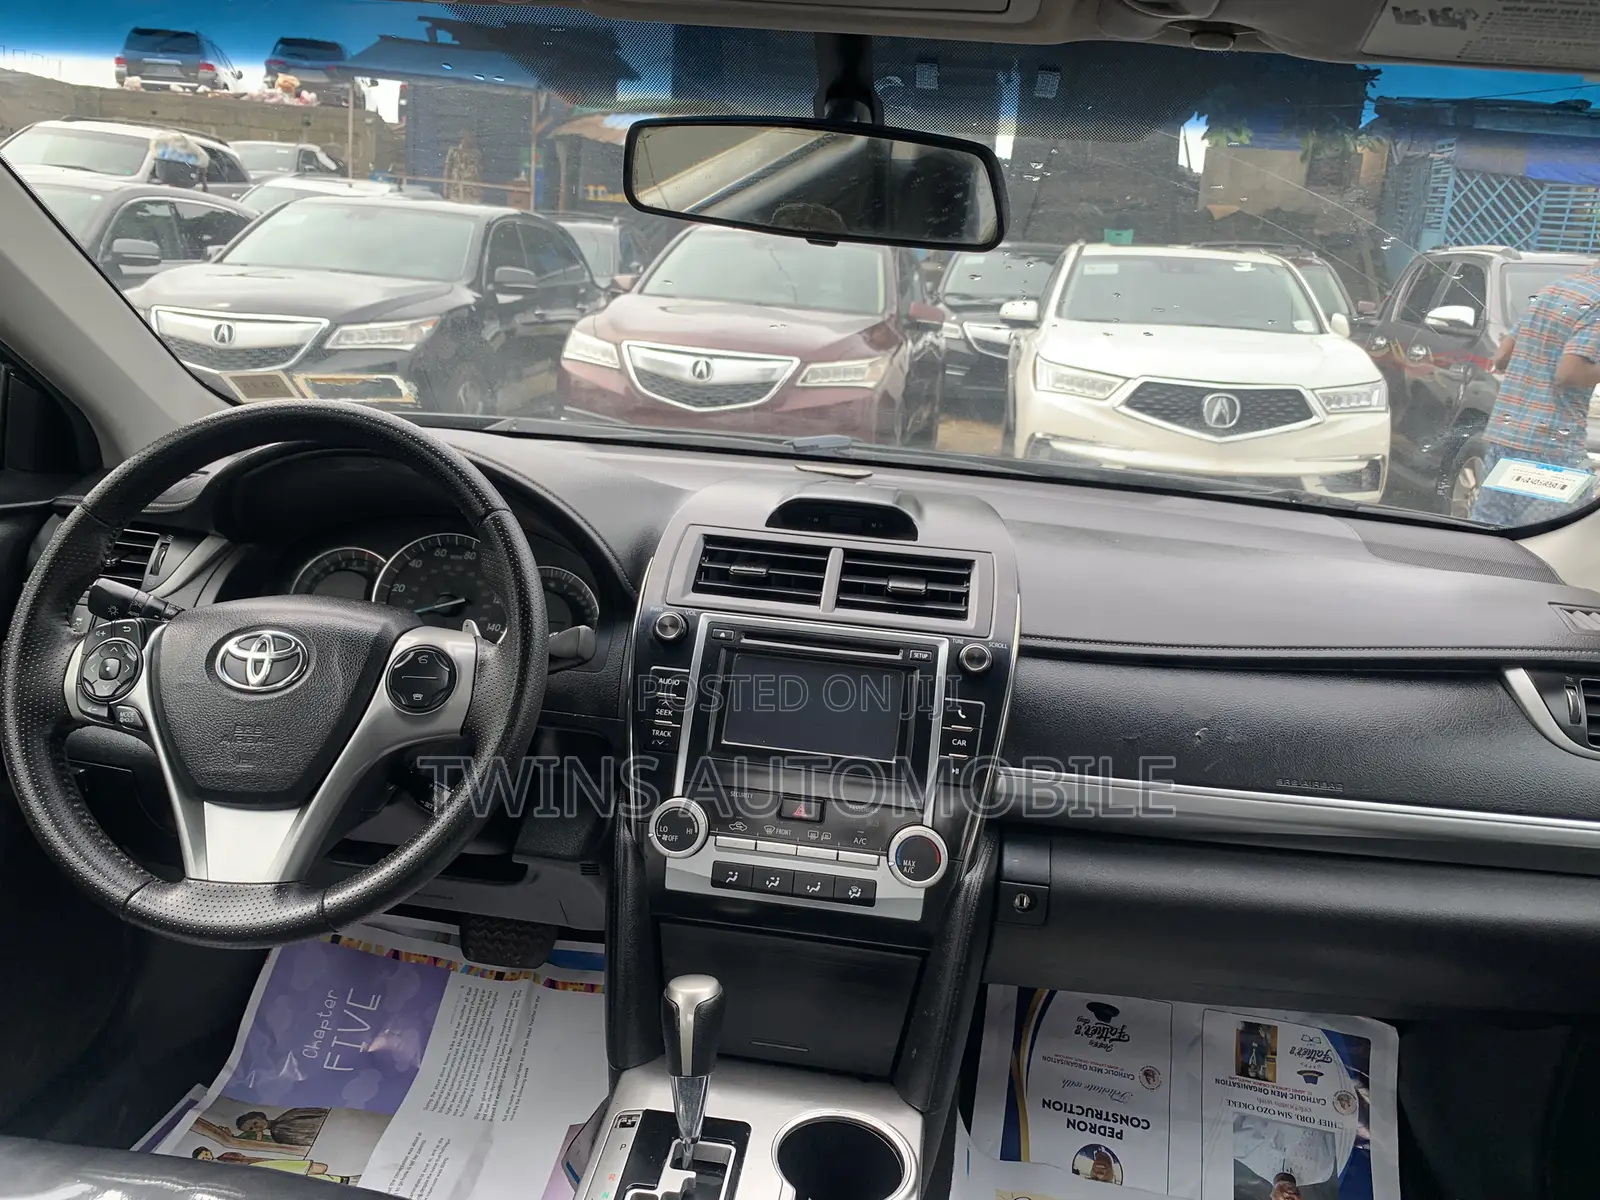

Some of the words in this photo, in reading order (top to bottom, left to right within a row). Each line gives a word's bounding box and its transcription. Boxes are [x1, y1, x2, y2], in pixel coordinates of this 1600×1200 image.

[434, 548, 448, 557] 60
[464, 552, 476, 560] 80
[408, 560, 422, 568] 40
[392, 584, 406, 592] 20
[486, 623, 501, 632] 140
[988, 642, 1008, 650] SCROLL
[658, 677, 680, 686] AUDIO
[656, 708, 674, 717] SEEK
[652, 728, 672, 738] TRACK
[952, 738, 967, 746] CAR
[730, 790, 754, 799] SECURITY
[776, 828, 792, 836] FRONT
[853, 837, 868, 846] A/C
[902, 860, 916, 868] MAX
[302, 990, 338, 1058] Chapter
[323, 988, 381, 1070] FIVE
[1074, 1022, 1130, 1042] Father's
[1289, 1046, 1333, 1064] Father's
[1042, 1055, 1088, 1070] ORGANISATION
[1088, 1064, 1104, 1074] MEN
[1104, 1068, 1135, 1080] CATHOLIC
[1214, 1078, 1268, 1096] ORGANISATION
[1270, 1088, 1288, 1100] MEN
[1288, 1092, 1326, 1106] CATHOLIC
[1226, 1099, 1255, 1110] OKEKE
[1042, 1098, 1151, 1130] CONSTRUCTION
[1256, 1106, 1276, 1116] OZO
[1277, 1109, 1293, 1119] SIM
[1066, 1118, 1124, 1140] PEDRON
[1318, 1119, 1344, 1130] CHIEF
